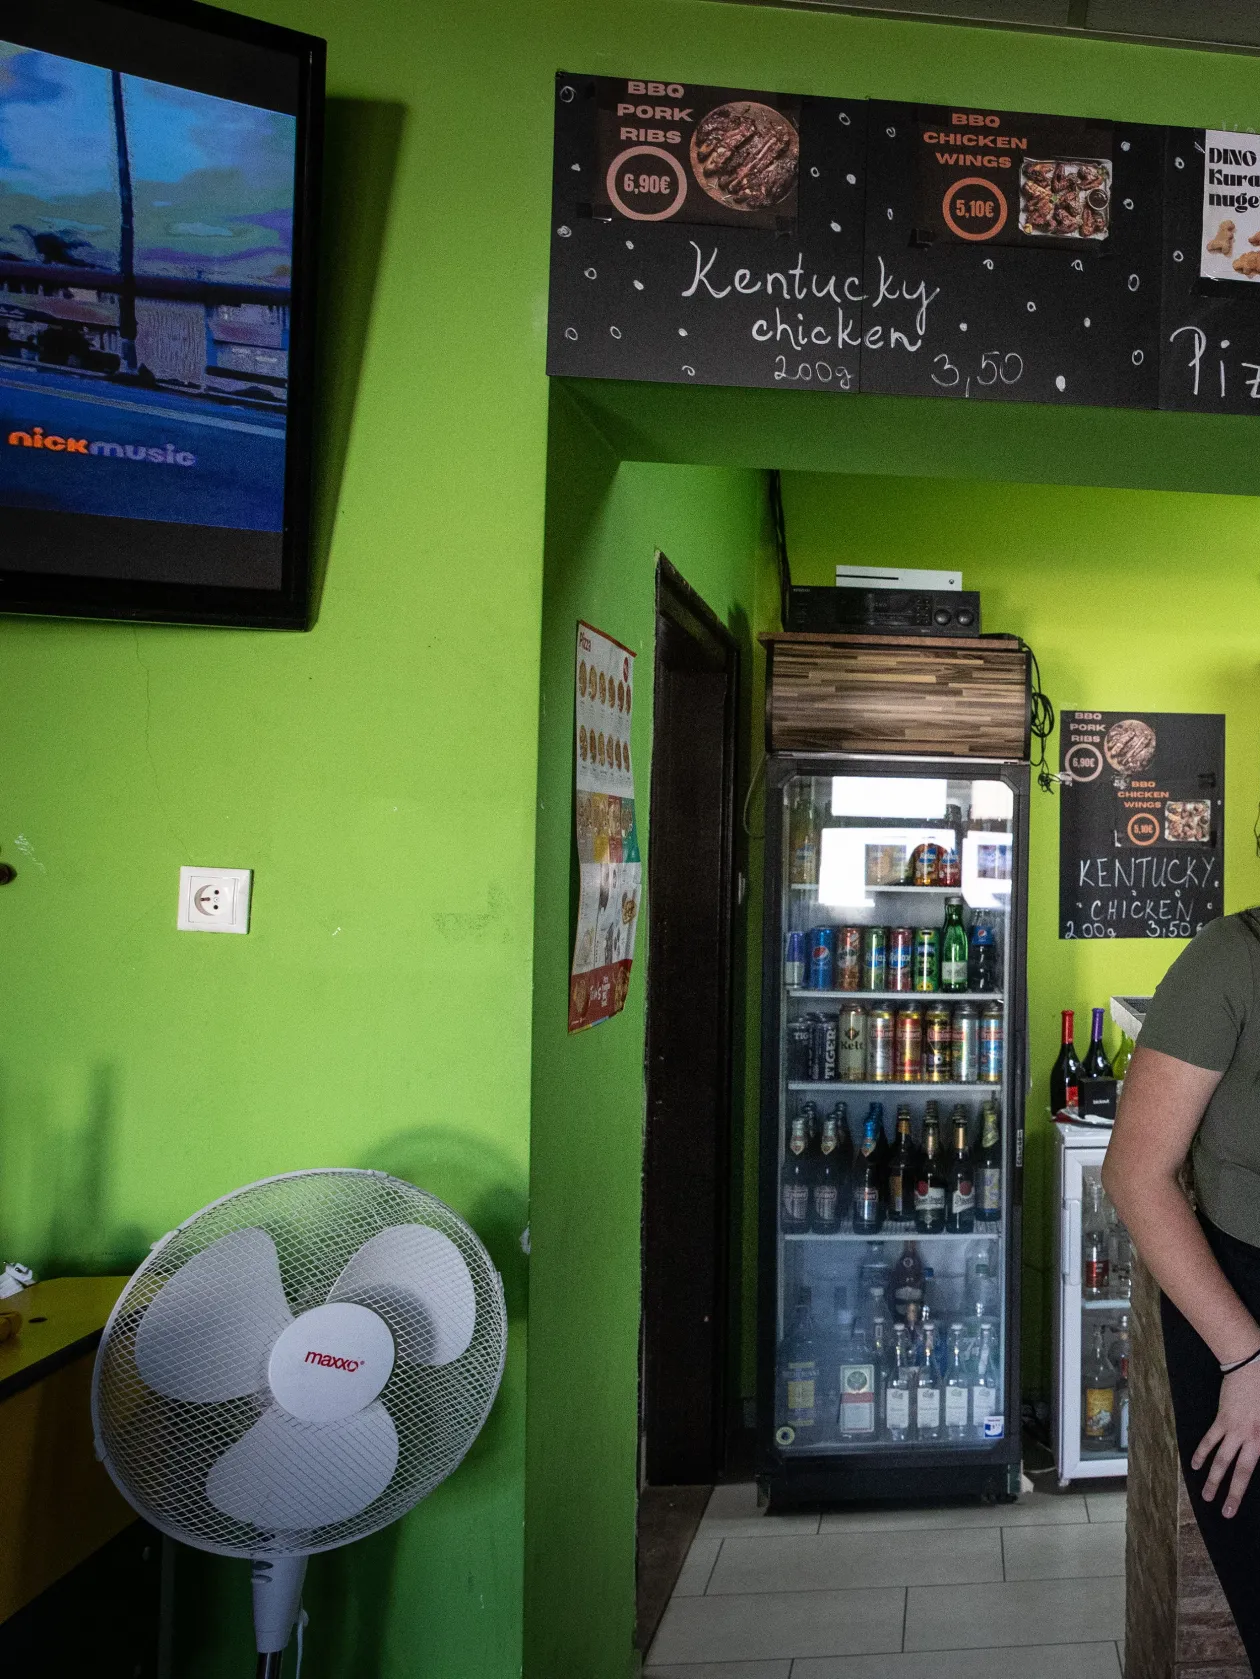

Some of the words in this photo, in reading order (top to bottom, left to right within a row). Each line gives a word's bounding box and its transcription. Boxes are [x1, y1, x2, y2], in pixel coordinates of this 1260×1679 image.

[627, 81, 685, 98] BBQ
[617, 103, 694, 122] PORK
[951, 113, 1001, 129] BBQ
[620, 127, 682, 144] RIBS
[923, 131, 1028, 151] CHICKEN
[935, 152, 1012, 169] WINGS
[1208, 147, 1257, 167] DINO
[623, 173, 671, 194] 6,90€
[955, 199, 994, 218] 5,10€
[682, 240, 940, 335] Kentucky
[752, 307, 922, 351] chicken
[774, 355, 855, 389] 200g
[931, 351, 1024, 398] 3,50
[1074, 712, 1102, 720] BBQ
[1070, 723, 1106, 732] PORK
[1071, 735, 1101, 743] RIBS
[1131, 780, 1156, 788] BBQ
[1124, 801, 1162, 809] WINGS
[1079, 856, 1215, 888] KENTUCKY
[1090, 900, 1193, 921] CHICKEN
[824, 1028, 837, 1080] TIGER
[304, 1351, 359, 1373] maxxo
